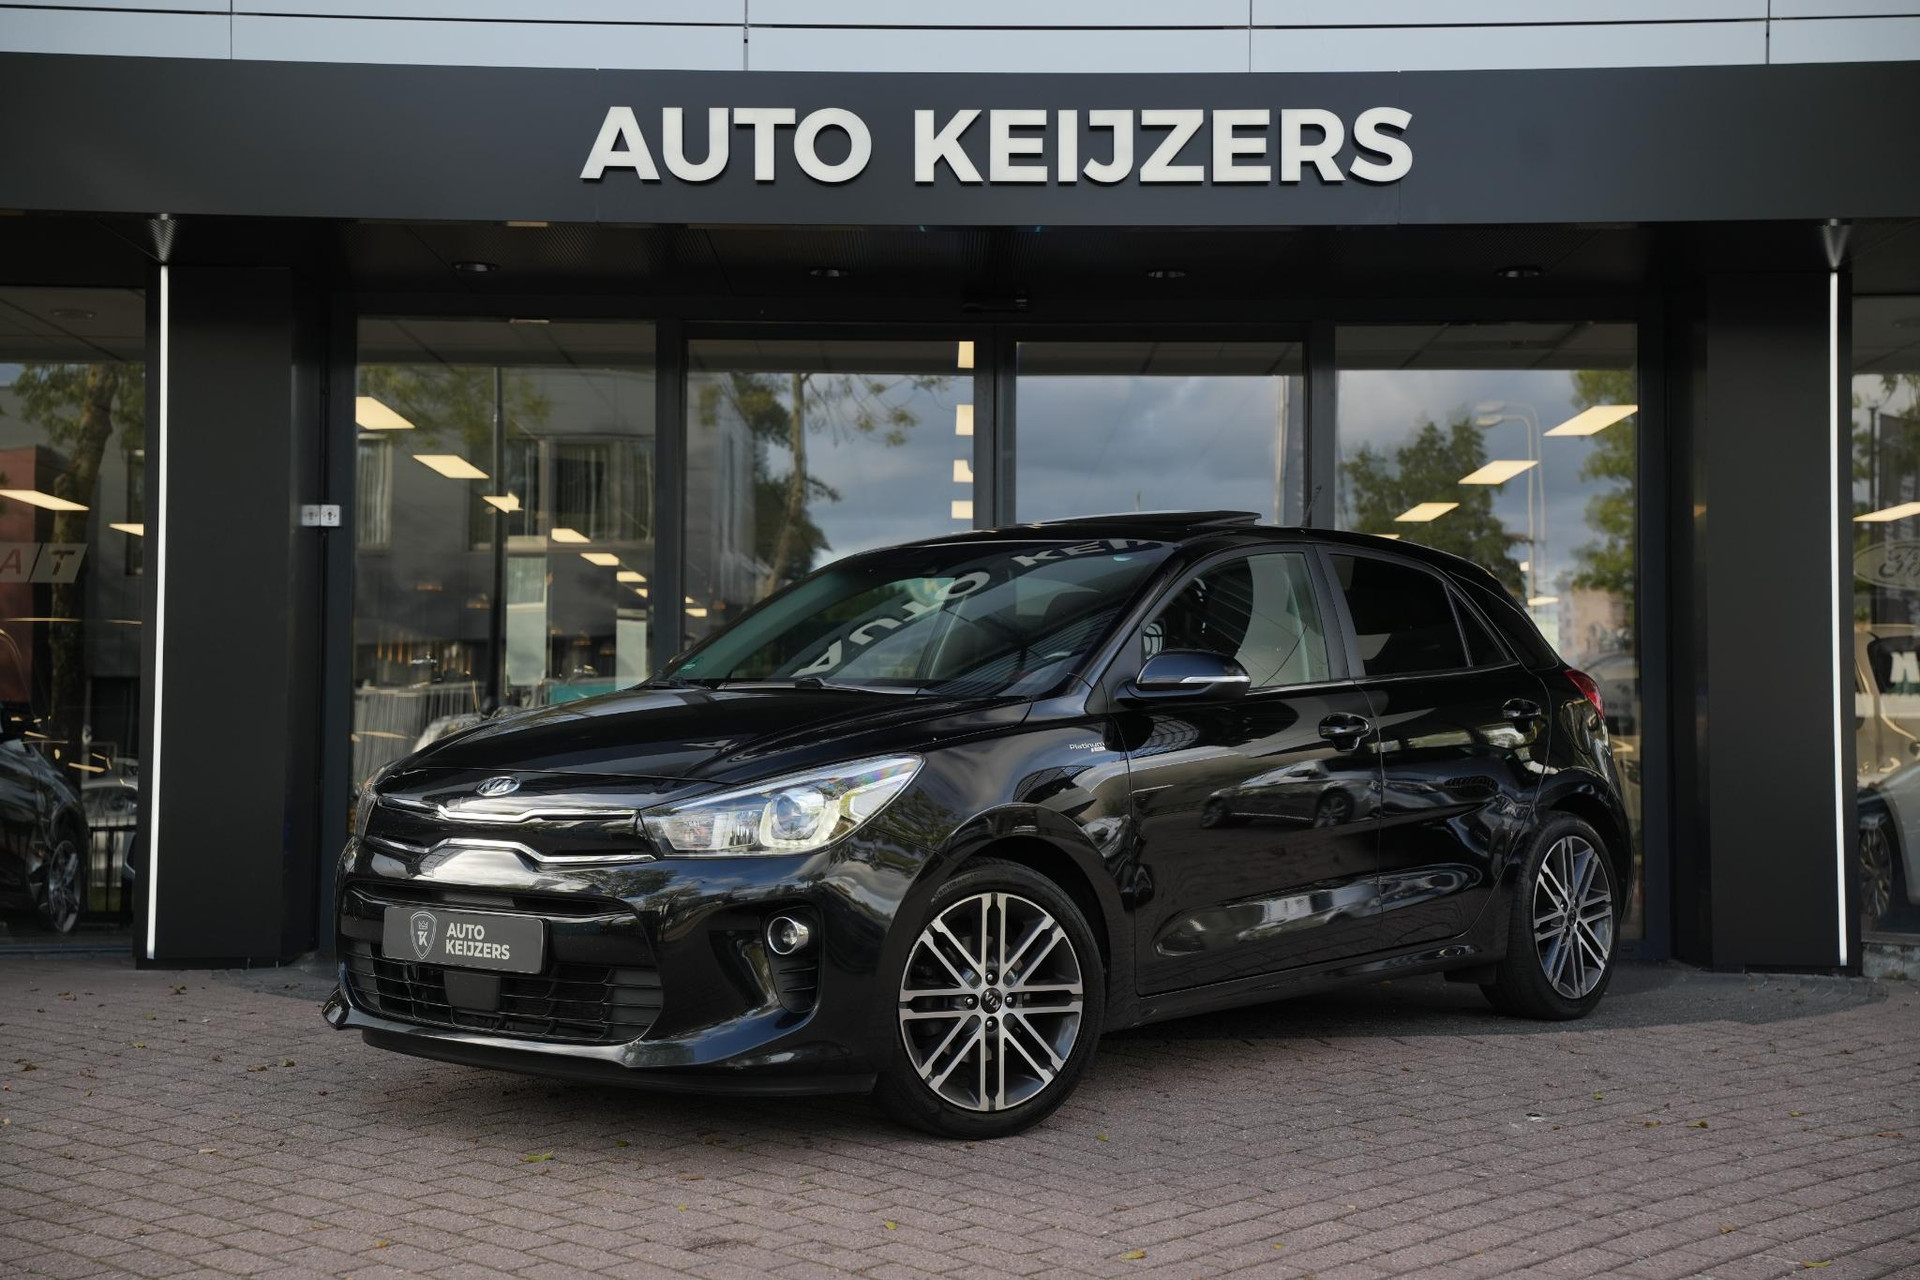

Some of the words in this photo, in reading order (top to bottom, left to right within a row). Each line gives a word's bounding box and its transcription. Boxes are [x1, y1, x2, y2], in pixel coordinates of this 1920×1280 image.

[579, 106, 872, 183] AUTO
[914, 106, 1414, 183] KEIJZERS
[478, 778, 513, 794] KIA
[446, 922, 485, 940] AUTO
[445, 939, 510, 960] KEIJZERS
